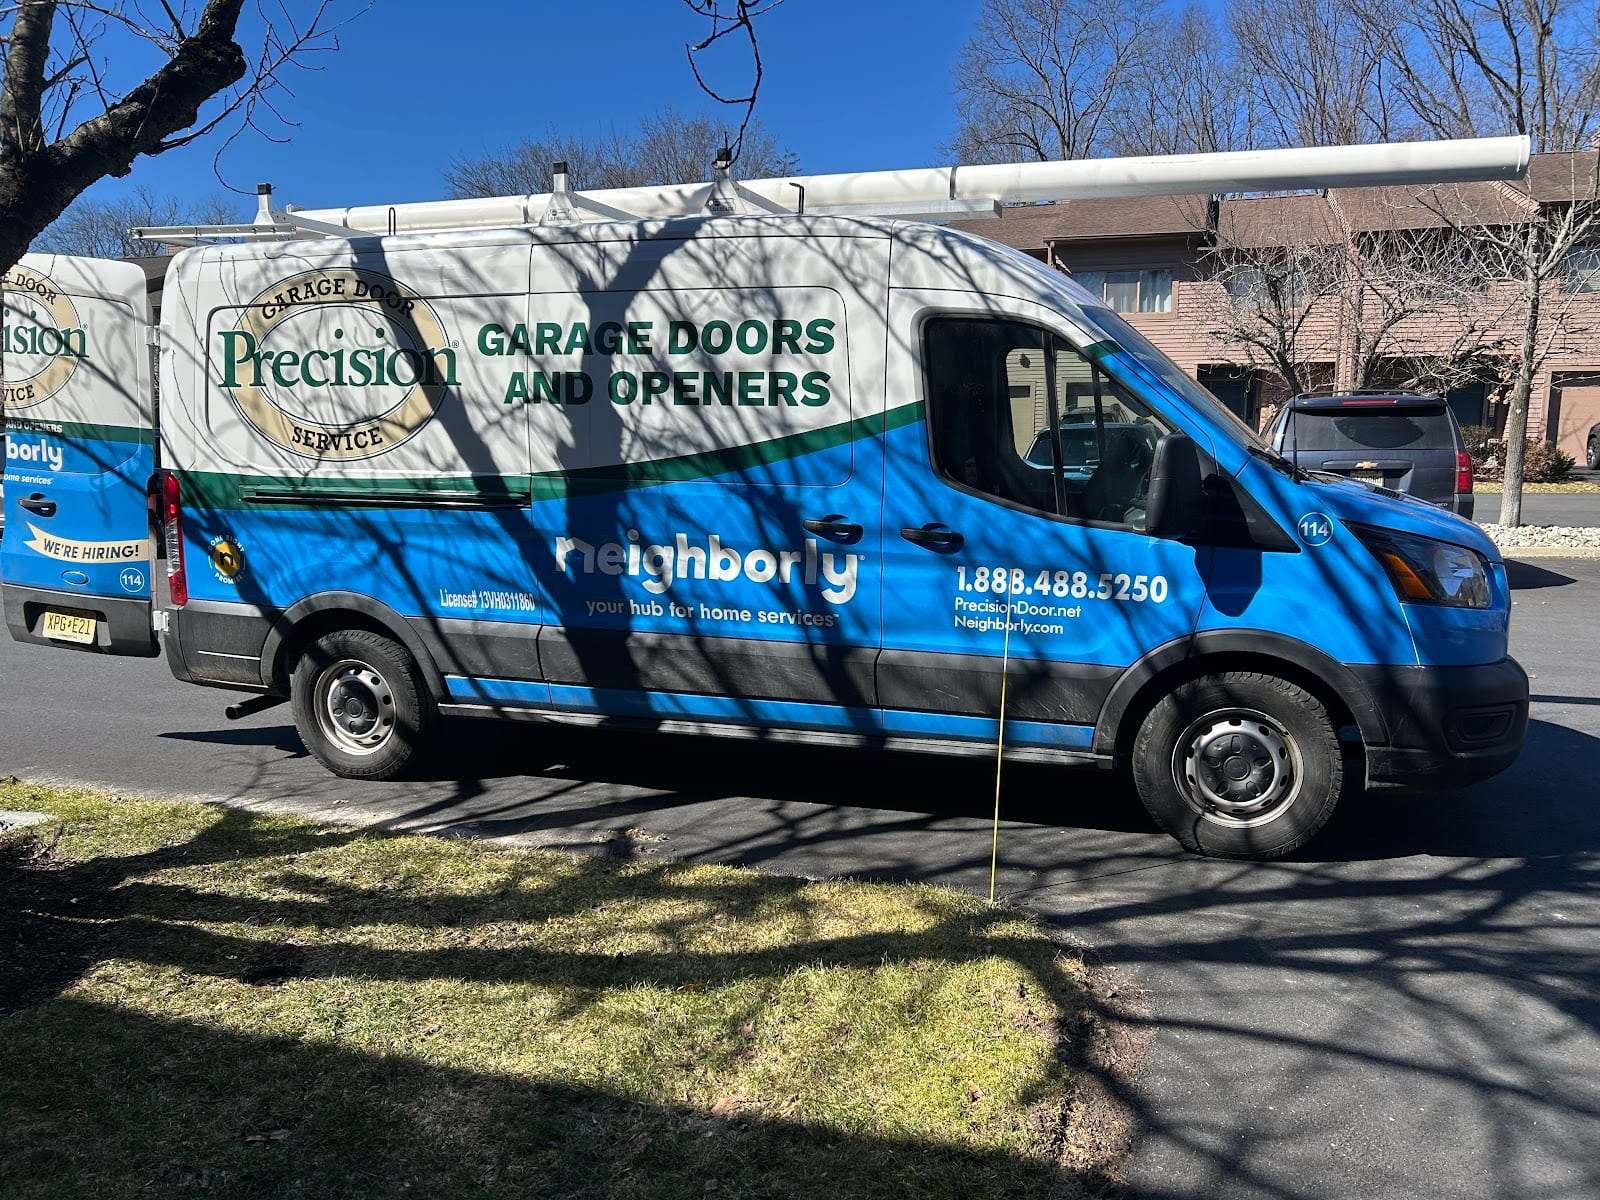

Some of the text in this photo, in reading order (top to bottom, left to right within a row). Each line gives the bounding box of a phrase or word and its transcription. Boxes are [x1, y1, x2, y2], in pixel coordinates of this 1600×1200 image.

[15, 273, 57, 305] DOOR
[262, 278, 415, 320] GARAGE DOOR
[477, 318, 836, 357] GARAGE DOORS
[217, 327, 462, 388] Precision
[503, 371, 832, 407] AND OPENERS
[6, 421, 63, 433] AND OPENERS
[291, 426, 384, 451] SERVICE
[21, 474, 52, 485] services
[1300, 521, 1329, 537] 114
[43, 538, 139, 560] WE'RE HIRING!
[555, 529, 858, 605] neighborly
[121, 574, 142, 586] 114
[957, 566, 1168, 604] 1.888.488.5250
[440, 588, 478, 608] License#
[955, 597, 1082, 618] PrecisionDoor.net
[586, 600, 836, 628] your hub for home services
[954, 615, 1064, 635] Neighborly.com
